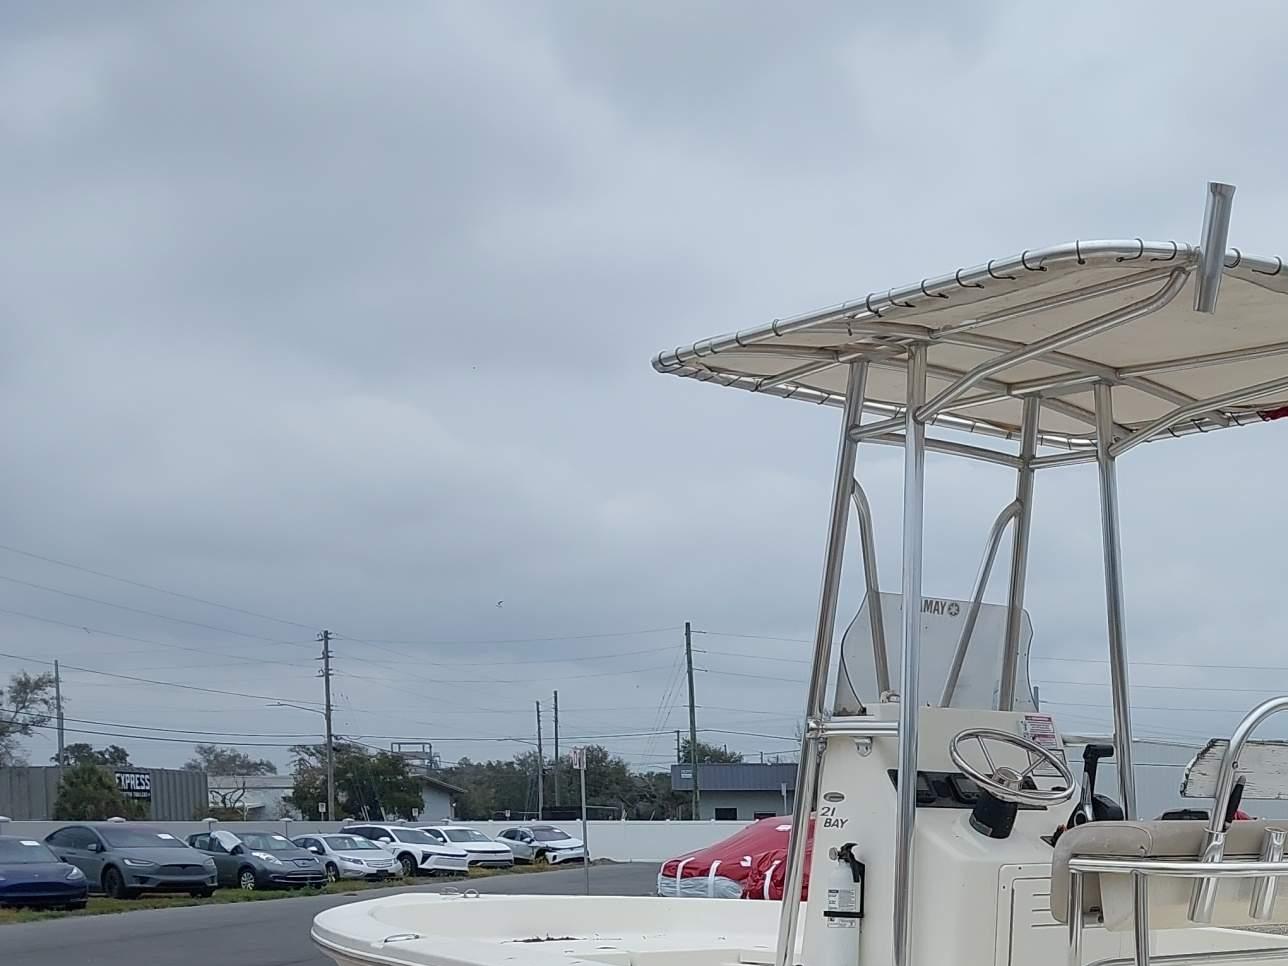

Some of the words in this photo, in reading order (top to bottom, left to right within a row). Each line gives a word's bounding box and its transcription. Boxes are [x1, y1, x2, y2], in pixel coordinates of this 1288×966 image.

[115, 773, 150, 790] EXPRESS
[820, 806, 836, 817] 21
[823, 817, 849, 829] BAY
